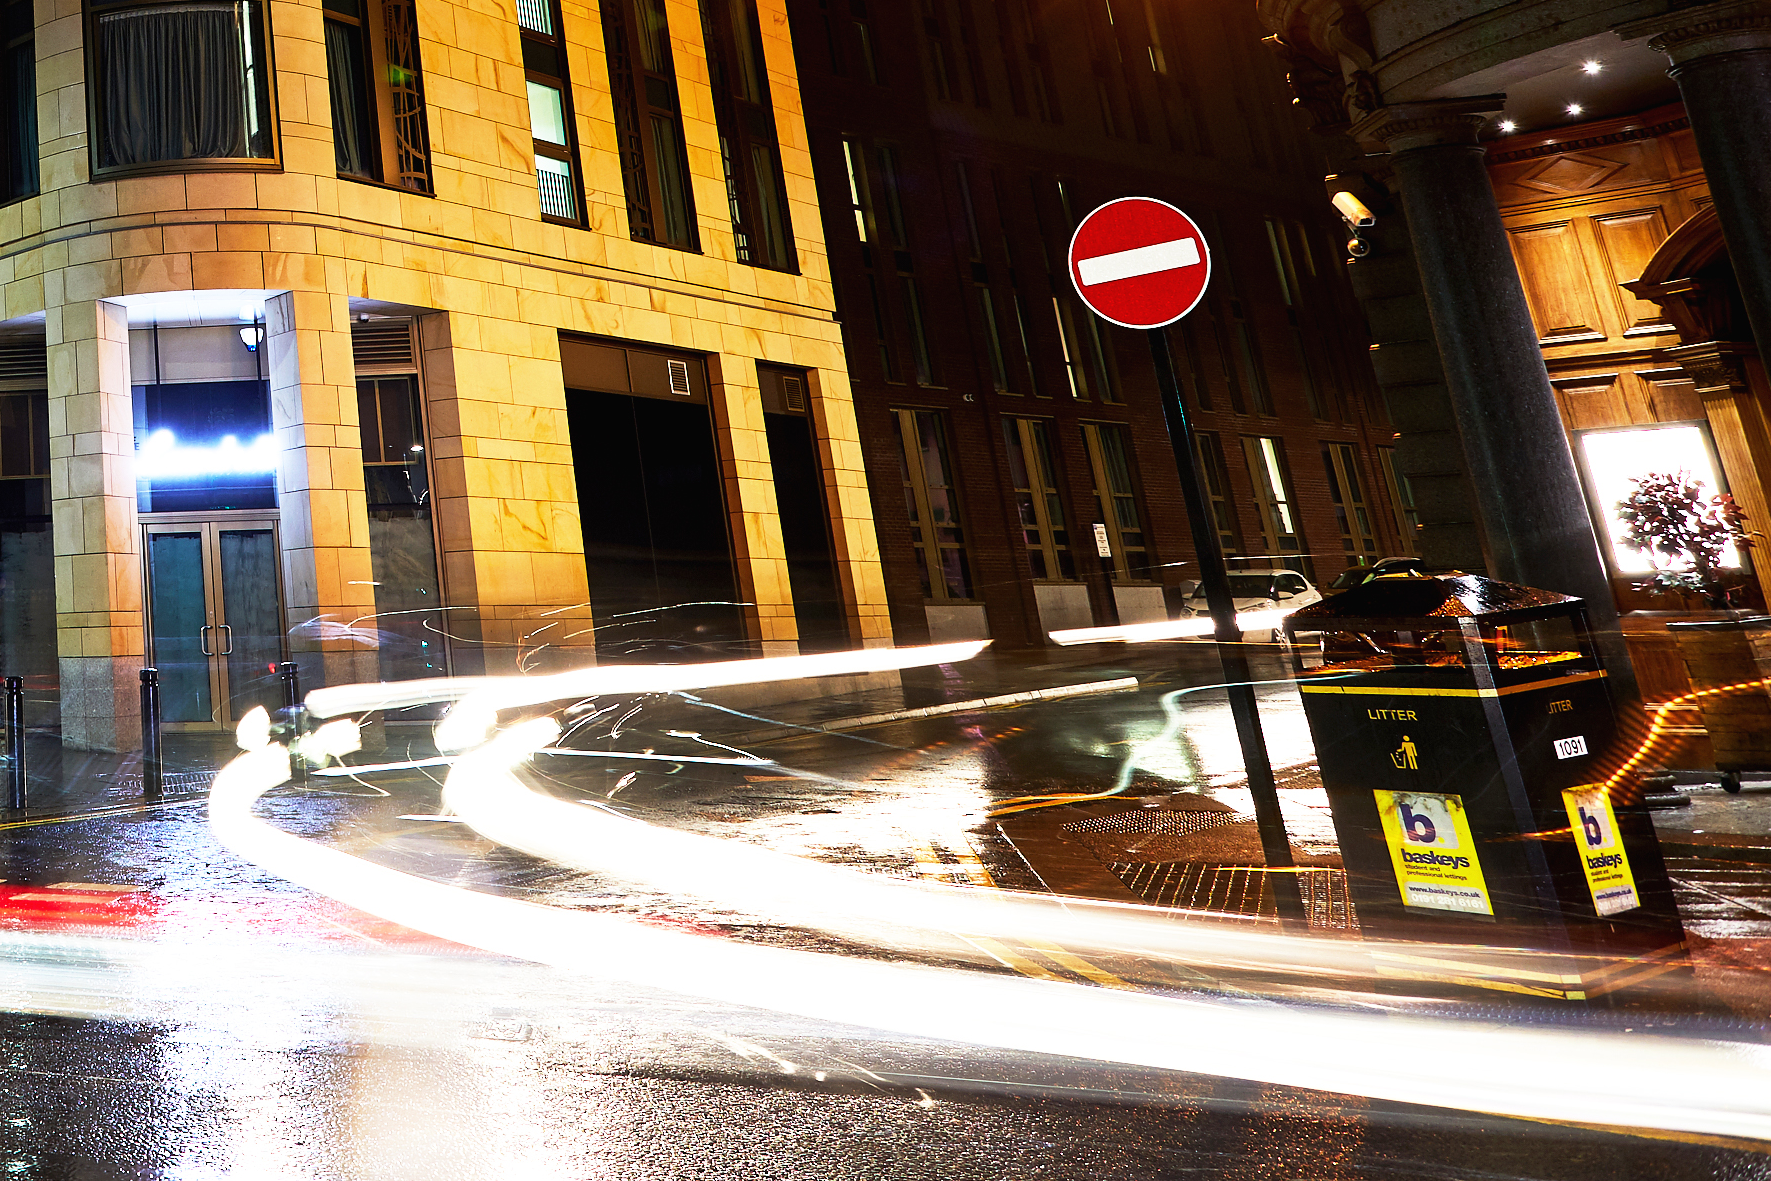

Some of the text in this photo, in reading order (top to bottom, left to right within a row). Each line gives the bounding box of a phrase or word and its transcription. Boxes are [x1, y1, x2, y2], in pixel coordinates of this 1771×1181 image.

[1367, 708, 1418, 721] LITTER
[1558, 737, 1584, 757] 1091
[1401, 848, 1470, 869] baskeys
[1586, 852, 1622, 869] baskeys
[1443, 873, 1467, 881] lettings
[1409, 886, 1480, 898] www.baskeys.co.uk
[1411, 893, 1435, 904] 0191
[1458, 898, 1484, 909] 6161
